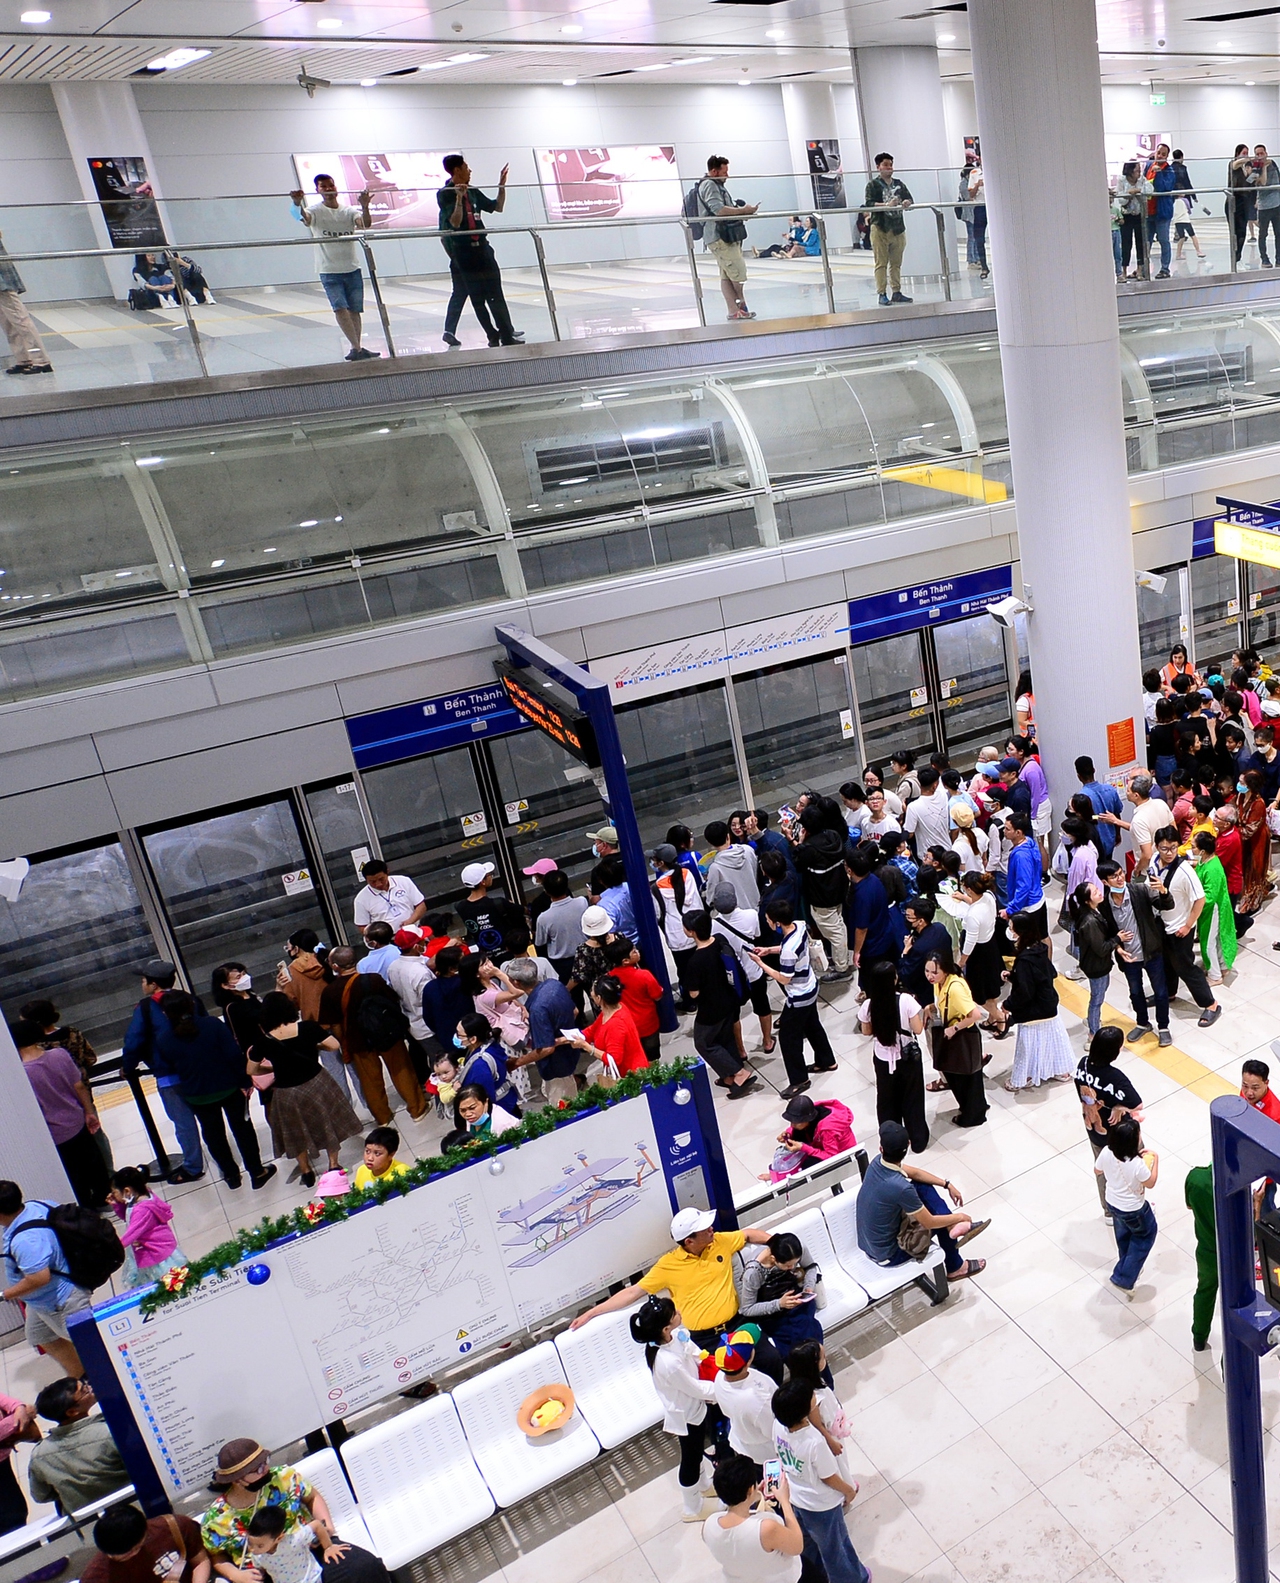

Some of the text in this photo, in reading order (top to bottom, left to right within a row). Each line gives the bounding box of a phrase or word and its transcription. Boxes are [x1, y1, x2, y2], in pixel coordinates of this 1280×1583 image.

[912, 582, 954, 599] Bến Thành
[918, 593, 948, 606] Ben Thanh
[444, 688, 503, 711] Bến Thành
[455, 702, 497, 718] Ben Thanh
[195, 1284, 207, 1294] Xe
[163, 1307, 173, 1316] for
[175, 1301, 192, 1310] Suoi
[193, 1293, 208, 1303] Tien
[210, 1279, 241, 1296] Terminal
[115, 1322, 126, 1331] L1
